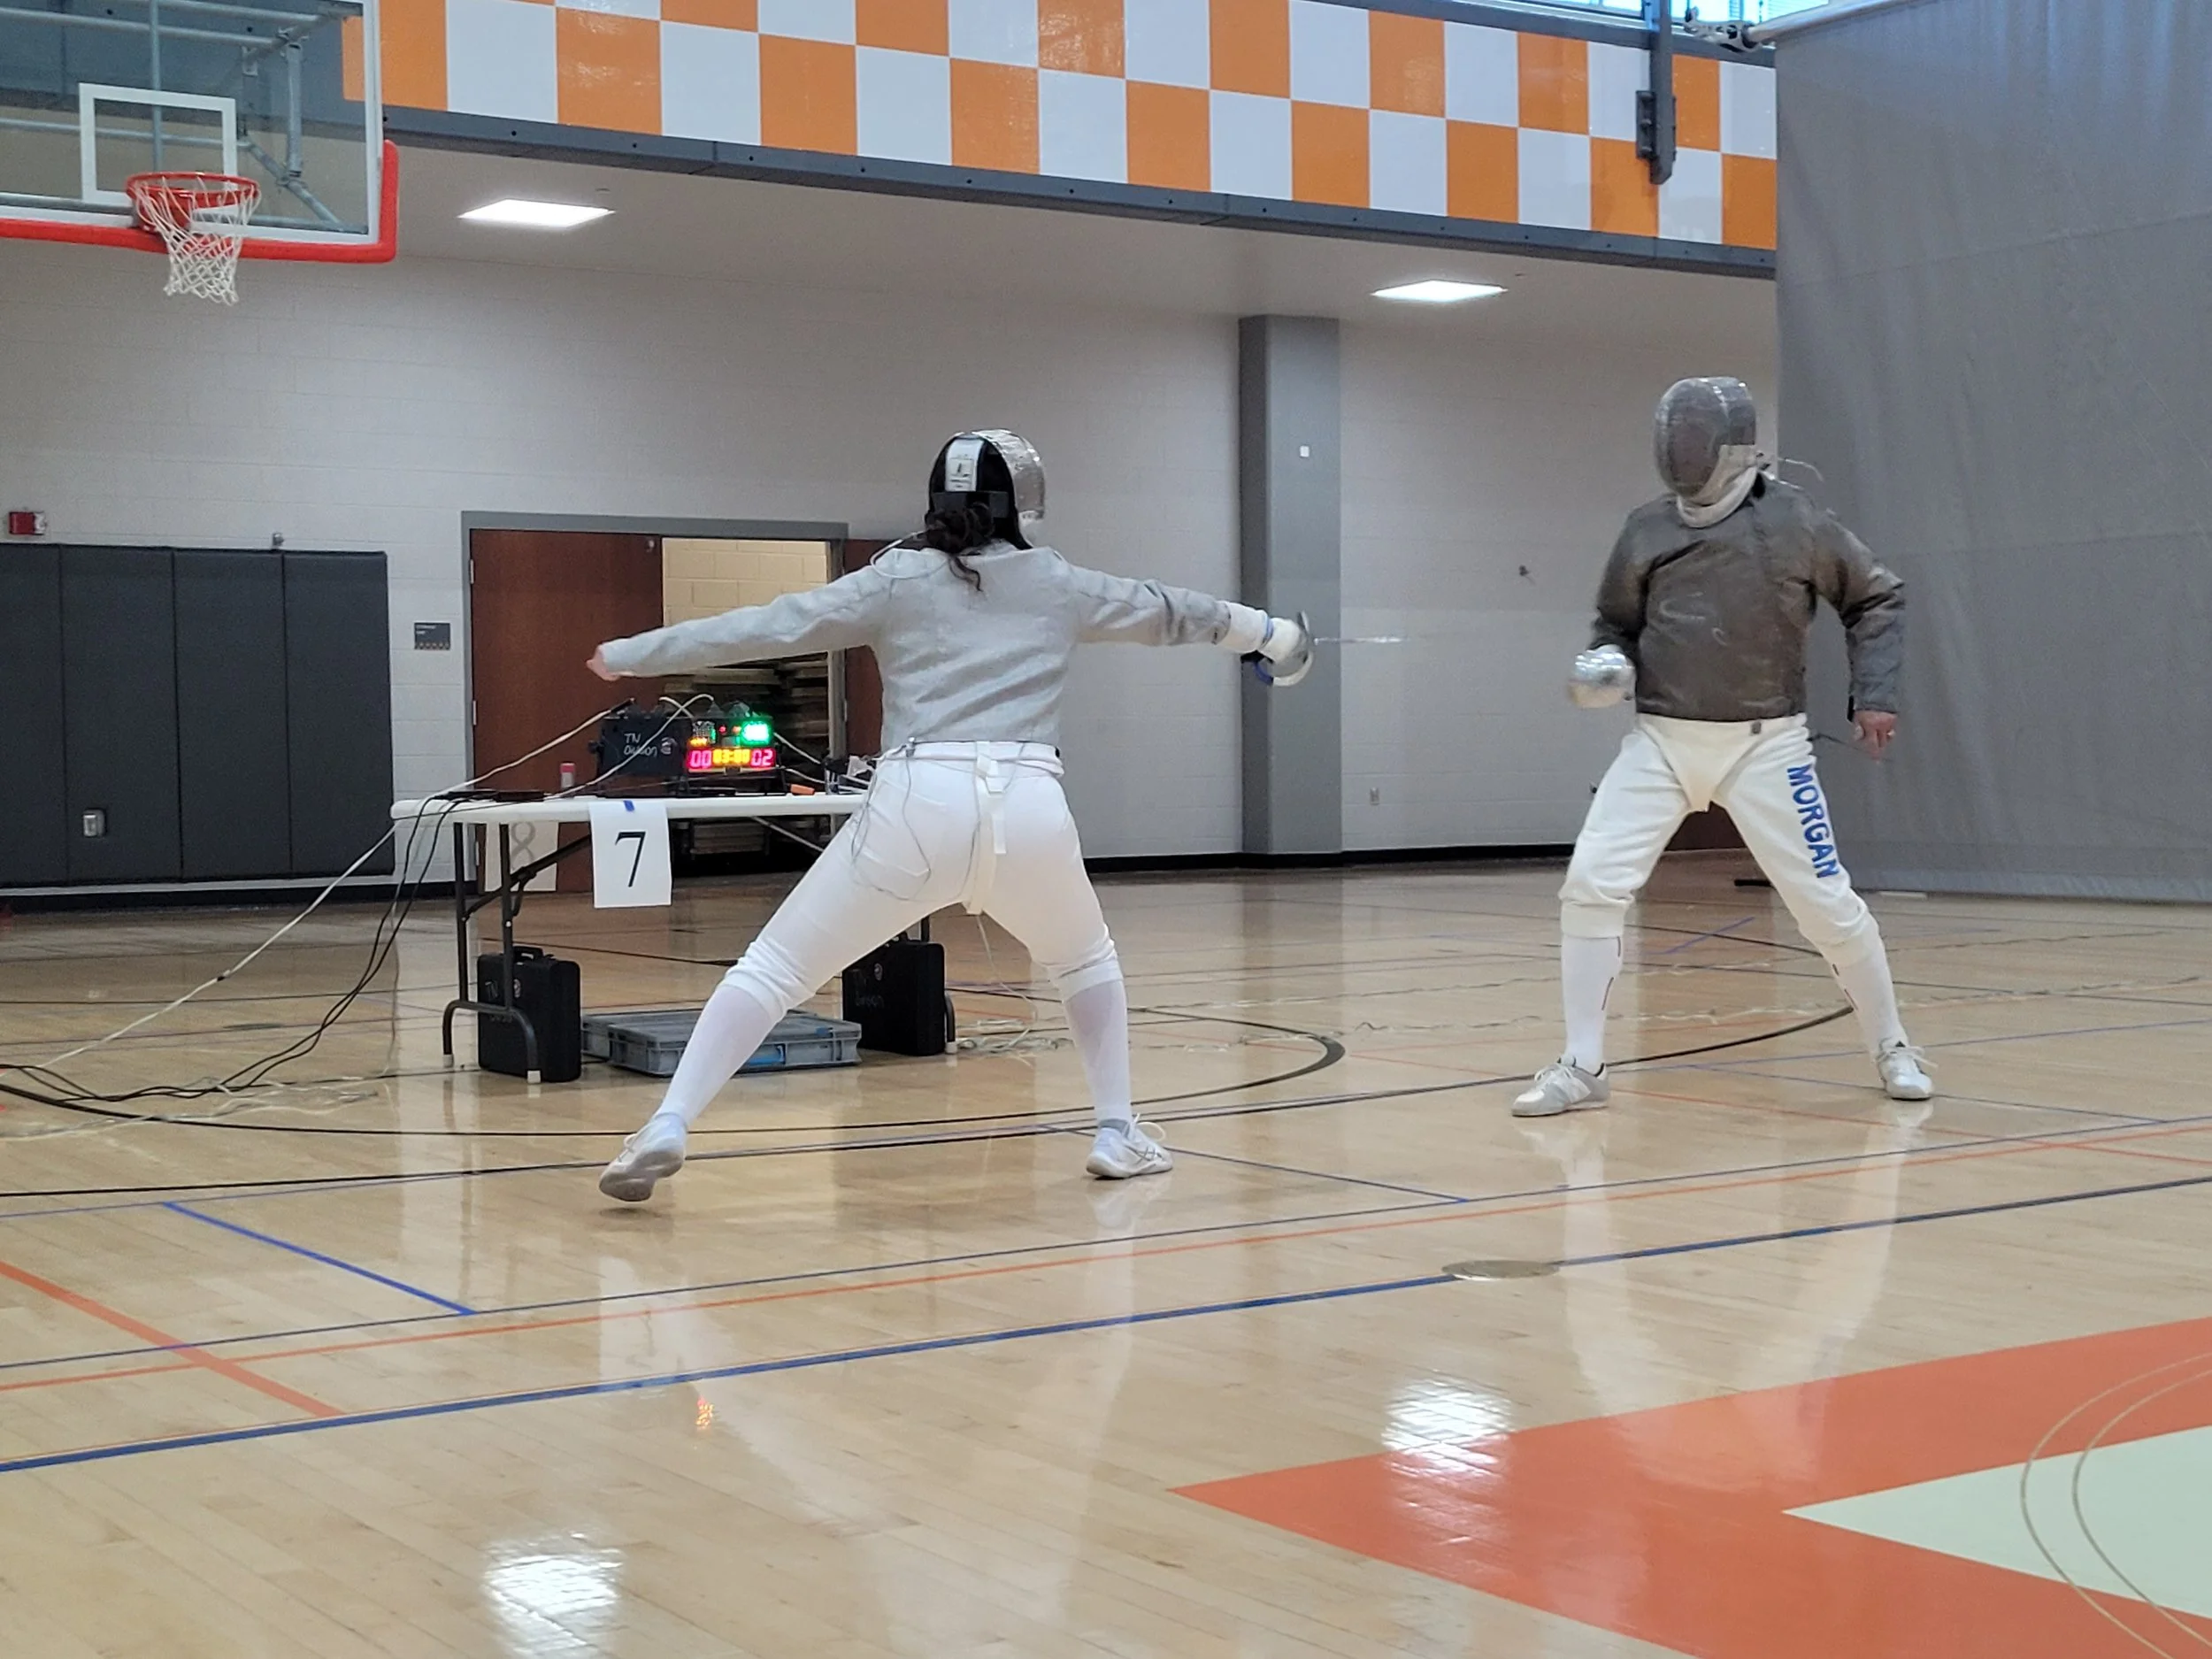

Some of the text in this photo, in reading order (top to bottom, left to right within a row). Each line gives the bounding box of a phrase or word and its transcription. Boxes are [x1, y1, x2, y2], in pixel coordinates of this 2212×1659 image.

[624, 733, 641, 743] TN
[690, 749, 711, 767] 00
[750, 749, 773, 766] 02
[1786, 763, 1840, 879] MORGAN
[614, 830, 647, 888] 7
